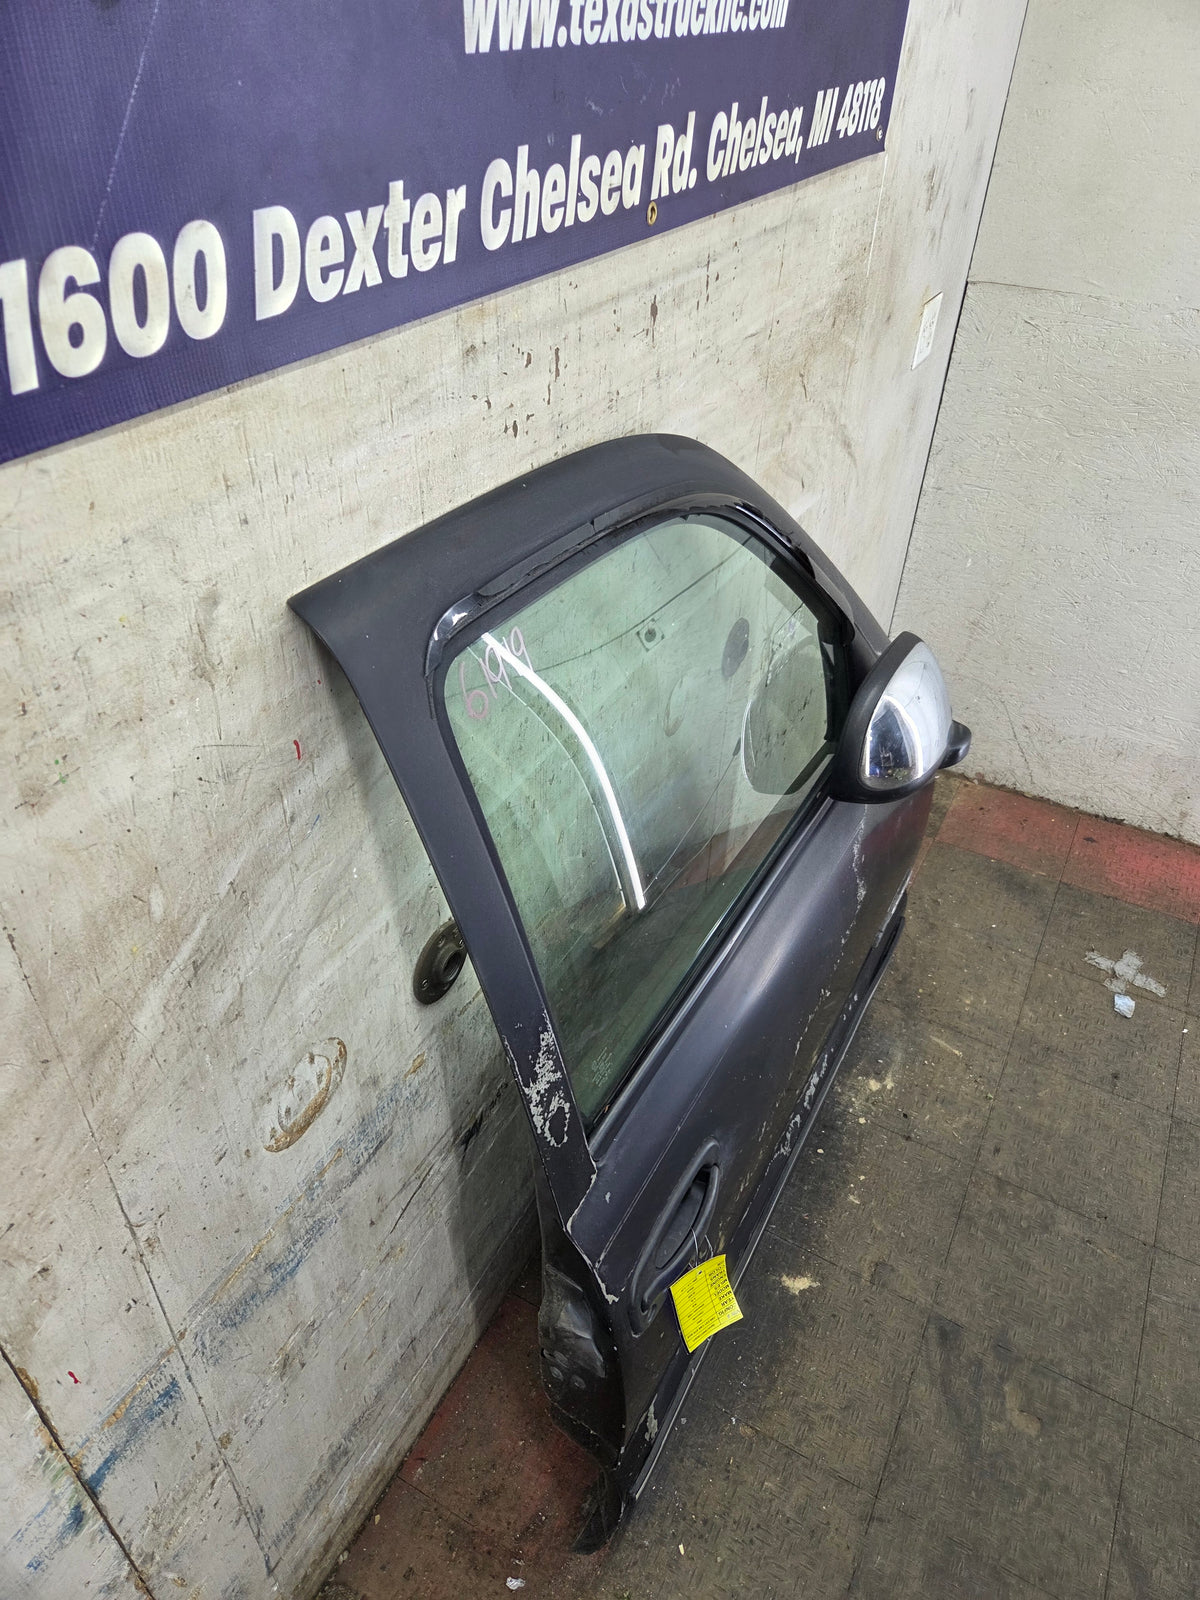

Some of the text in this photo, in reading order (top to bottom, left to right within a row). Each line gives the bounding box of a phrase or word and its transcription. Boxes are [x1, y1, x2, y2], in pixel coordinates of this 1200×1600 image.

[0, 76, 886, 396] 1600 Dexter Chelsea Rd. Chelsea, MI 48118
